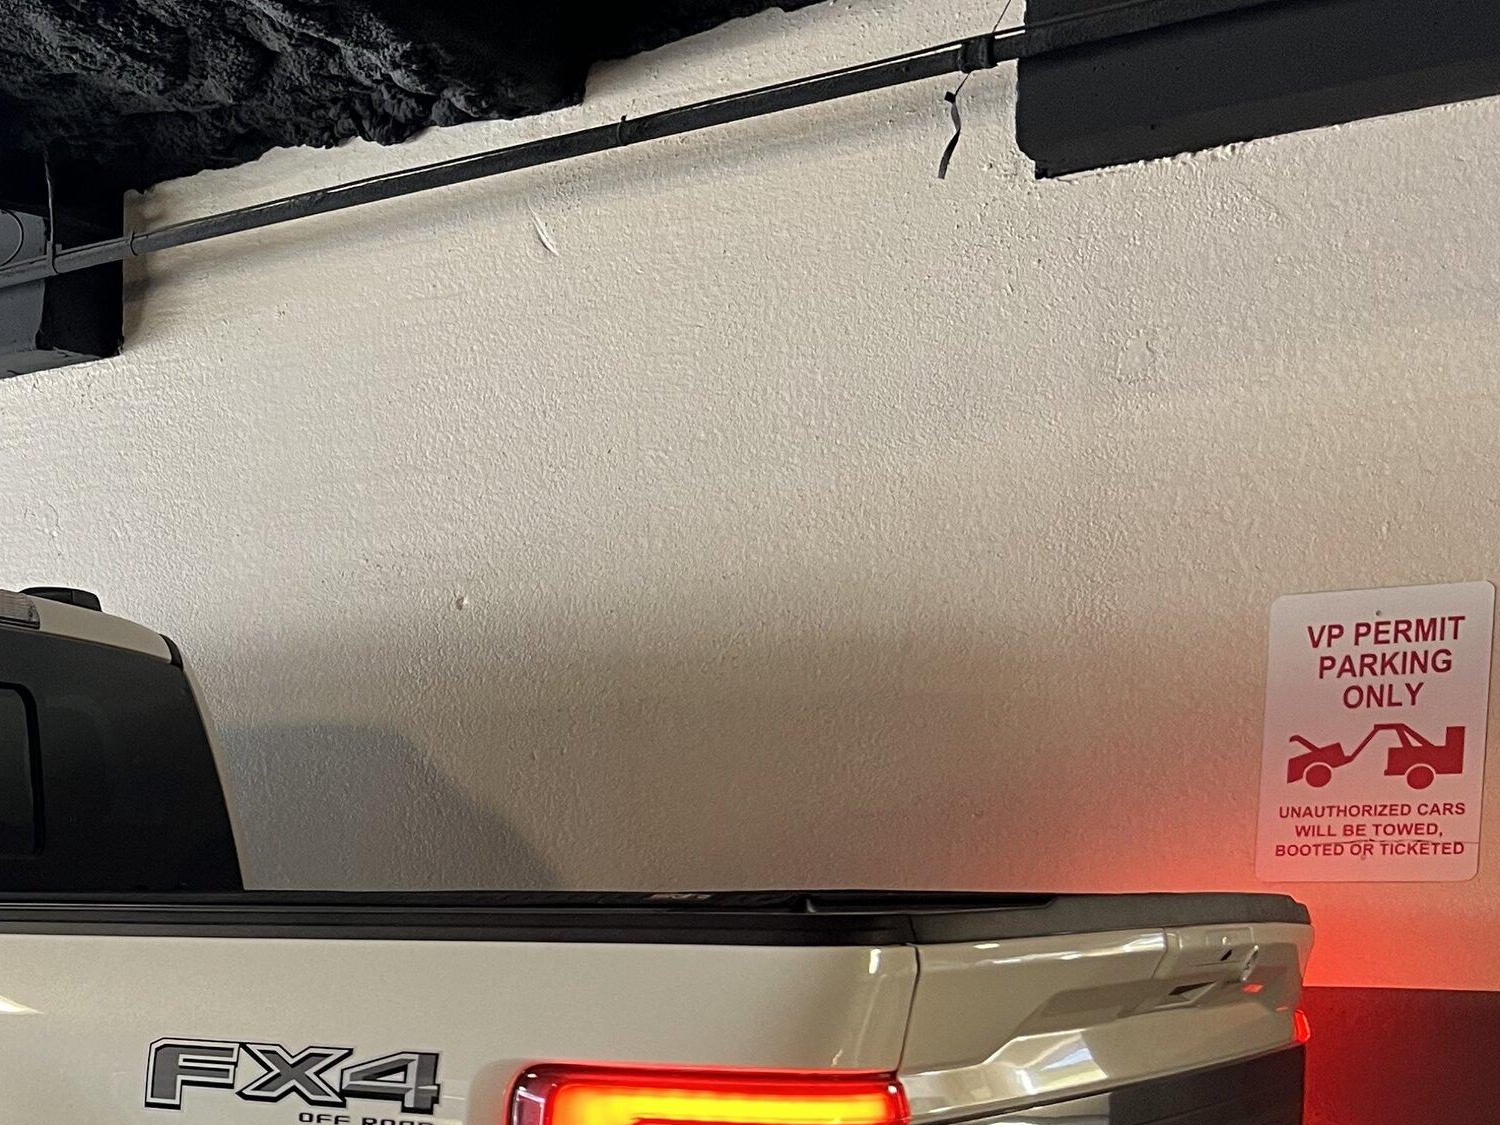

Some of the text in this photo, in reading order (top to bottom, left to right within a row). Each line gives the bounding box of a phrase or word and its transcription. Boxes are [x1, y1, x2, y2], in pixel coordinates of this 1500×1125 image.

[1307, 616, 1466, 648] VP PERMIT
[1318, 649, 1453, 679] PARKING
[1343, 682, 1424, 709] ONLY
[1279, 803, 1466, 819] UNAUTHORIZED CARS
[1295, 823, 1443, 838] WILL BE TOWED,
[1275, 842, 1465, 857] BOOTED OR TICKETED
[144, 1037, 441, 1115] FX4
[299, 1112, 351, 1125] OFF
